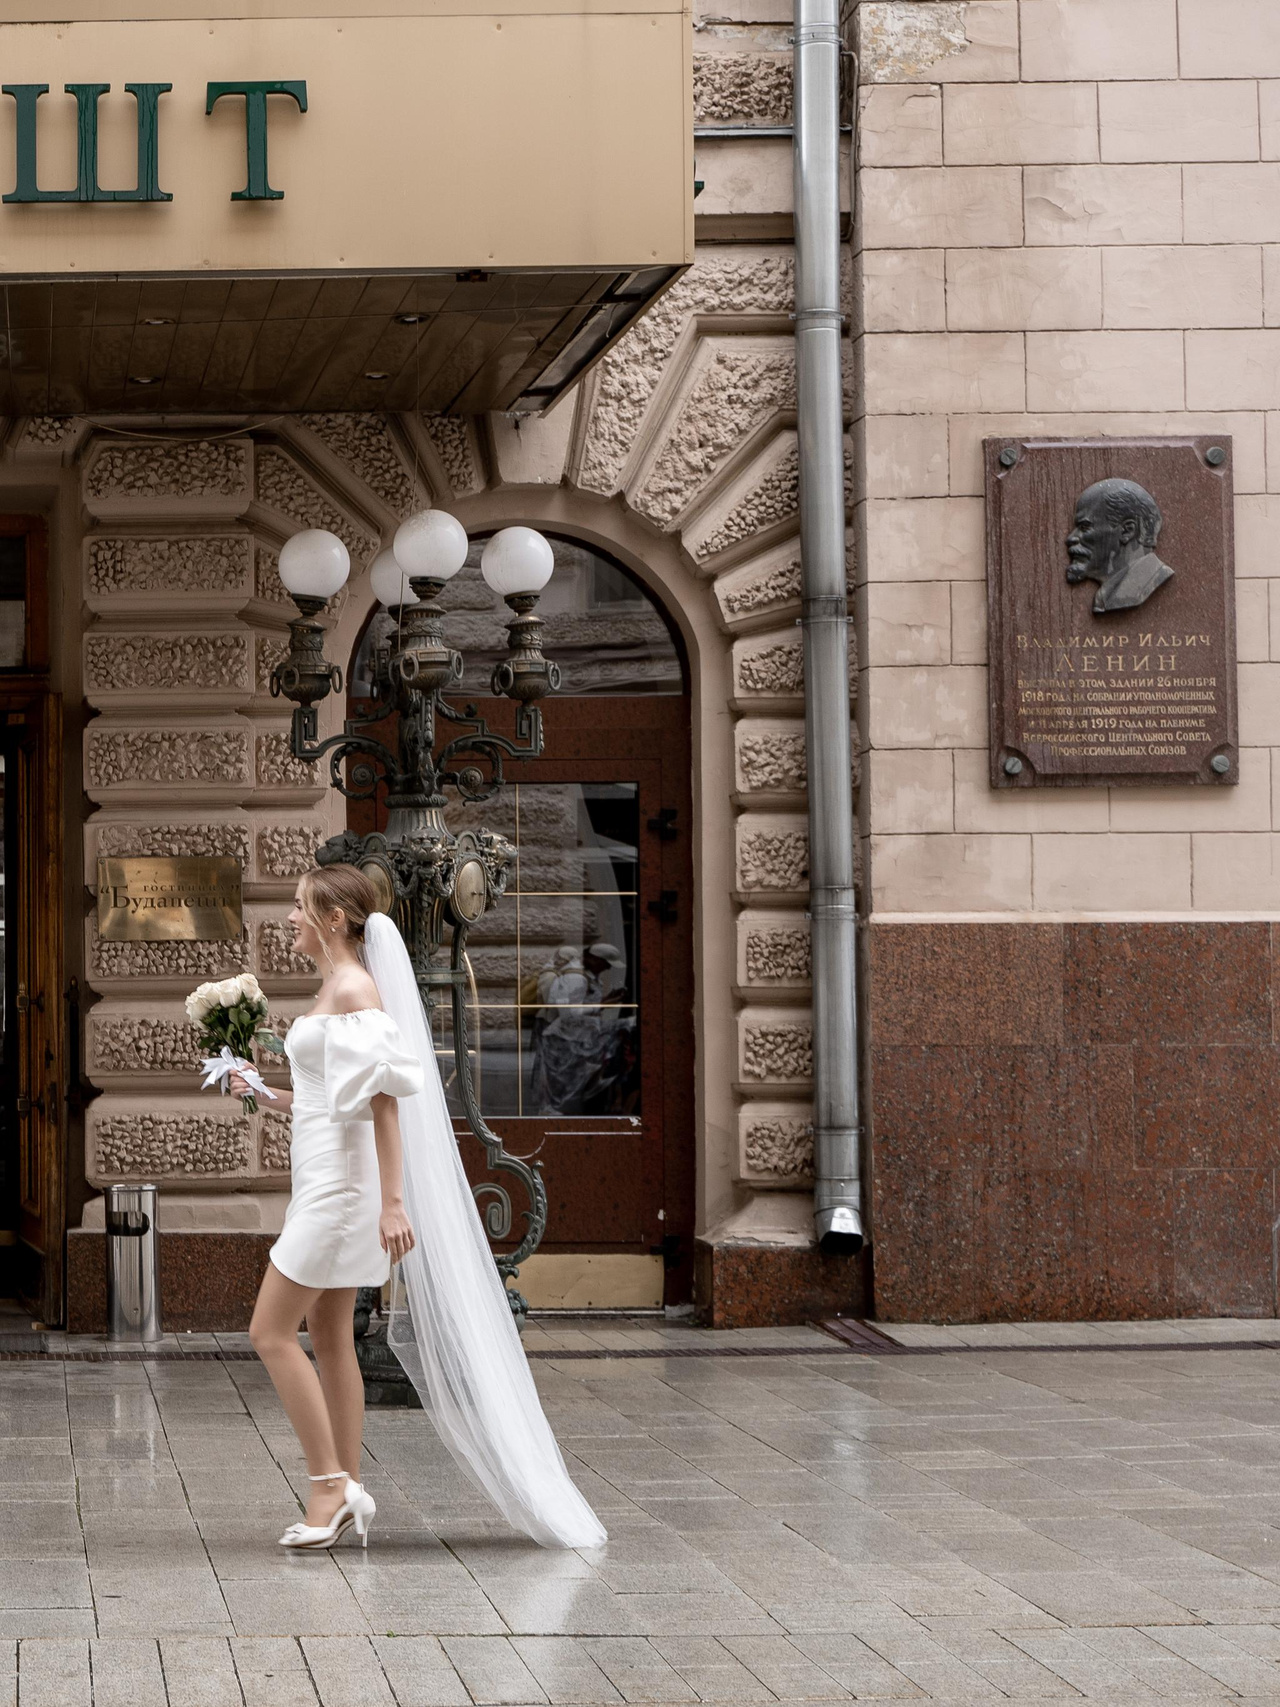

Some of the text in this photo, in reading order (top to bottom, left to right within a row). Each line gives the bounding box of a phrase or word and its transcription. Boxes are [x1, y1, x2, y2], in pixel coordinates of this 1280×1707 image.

[1138, 632, 1212, 648] ИЛЬИЧ
[1055, 653, 1177, 673] ЛЕНИН
[1078, 678, 1108, 688] ЭТОМ
[1109, 678, 1155, 688] ЗДАНИИ
[1156, 675, 1172, 688] 26
[1172, 677, 1217, 687] НОЯБРЯ
[1021, 690, 1045, 702] 1918
[1091, 717, 1117, 729] 1919
[1118, 719, 1144, 729] ГОДА
[1144, 719, 1159, 728] НА
[1160, 718, 1206, 728] ПЛЕНУМЕ
[1107, 731, 1174, 742] ЦЕНТРАЛЬНОГО
[1175, 730, 1212, 742] СОВЕТА
[1147, 743, 1187, 756] СОЮЗОВ
